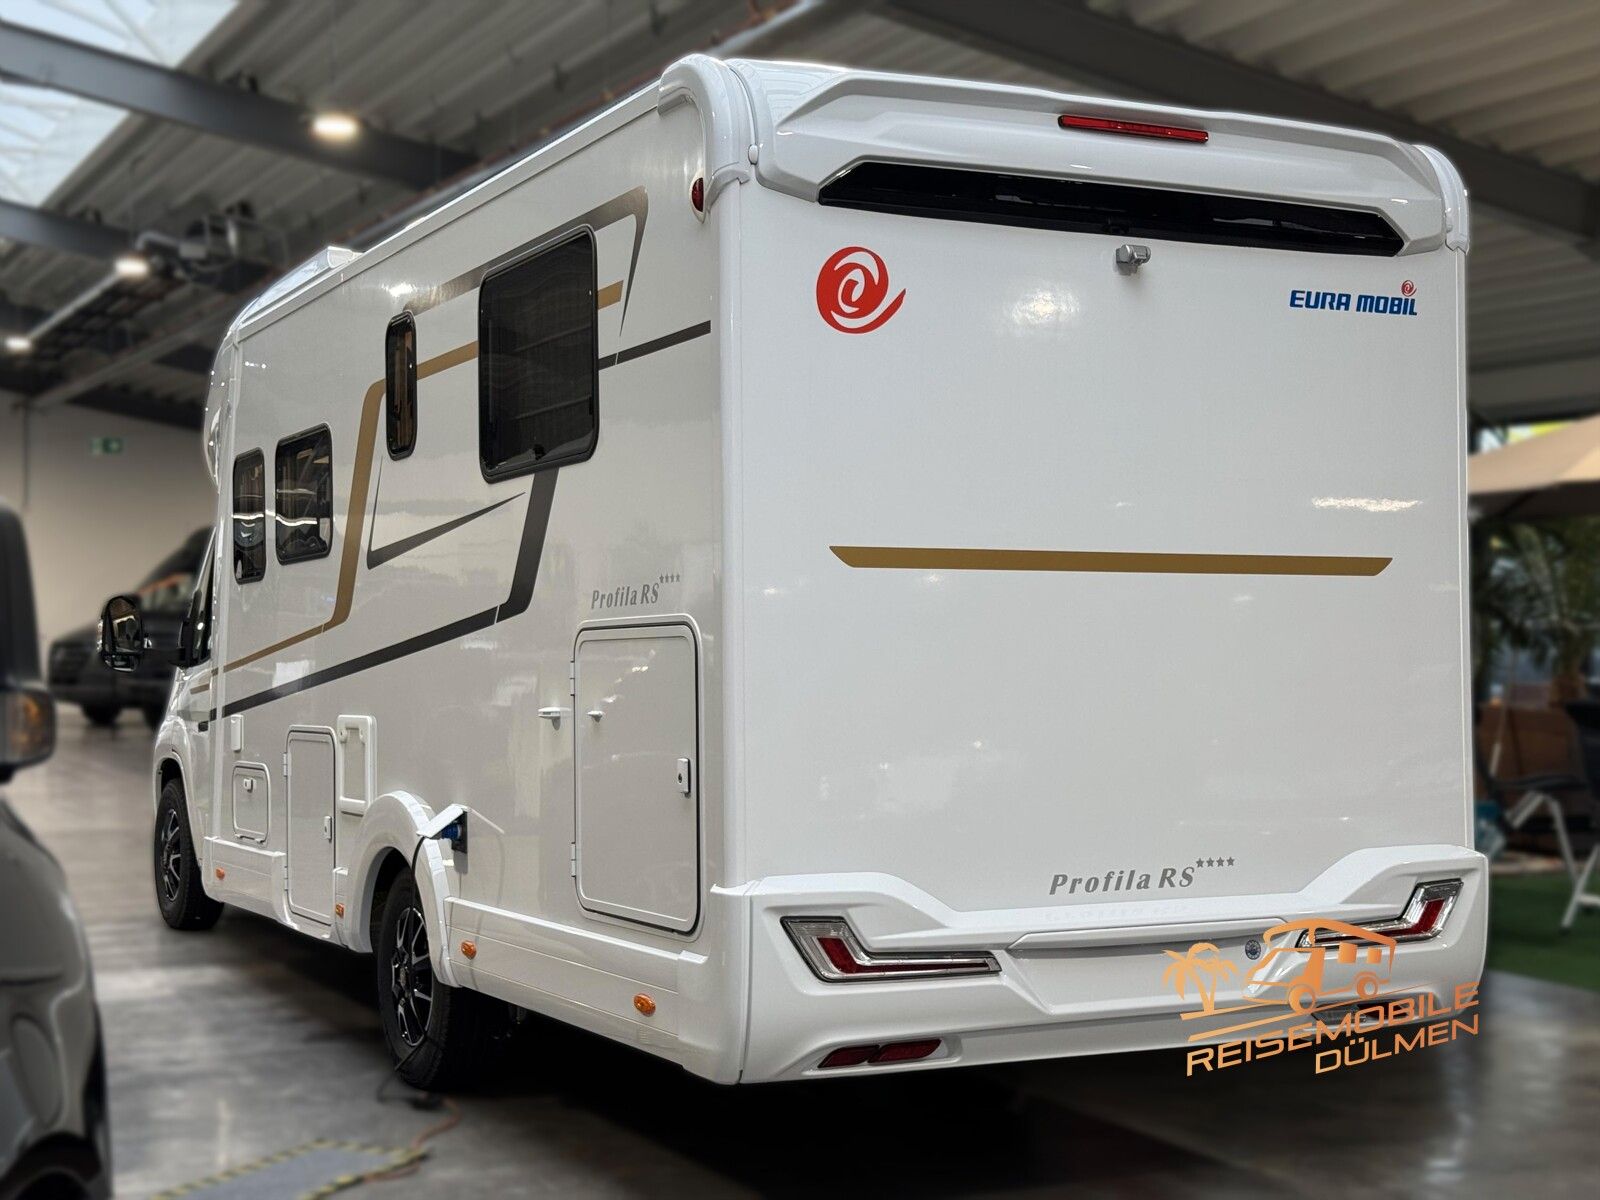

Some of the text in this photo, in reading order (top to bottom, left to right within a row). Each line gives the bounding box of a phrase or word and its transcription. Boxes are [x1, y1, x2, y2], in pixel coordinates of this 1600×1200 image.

[1289, 289, 1417, 316] EURA MOBIL
[591, 582, 660, 609] Profila RS
[1049, 866, 1195, 895] Profila RS
